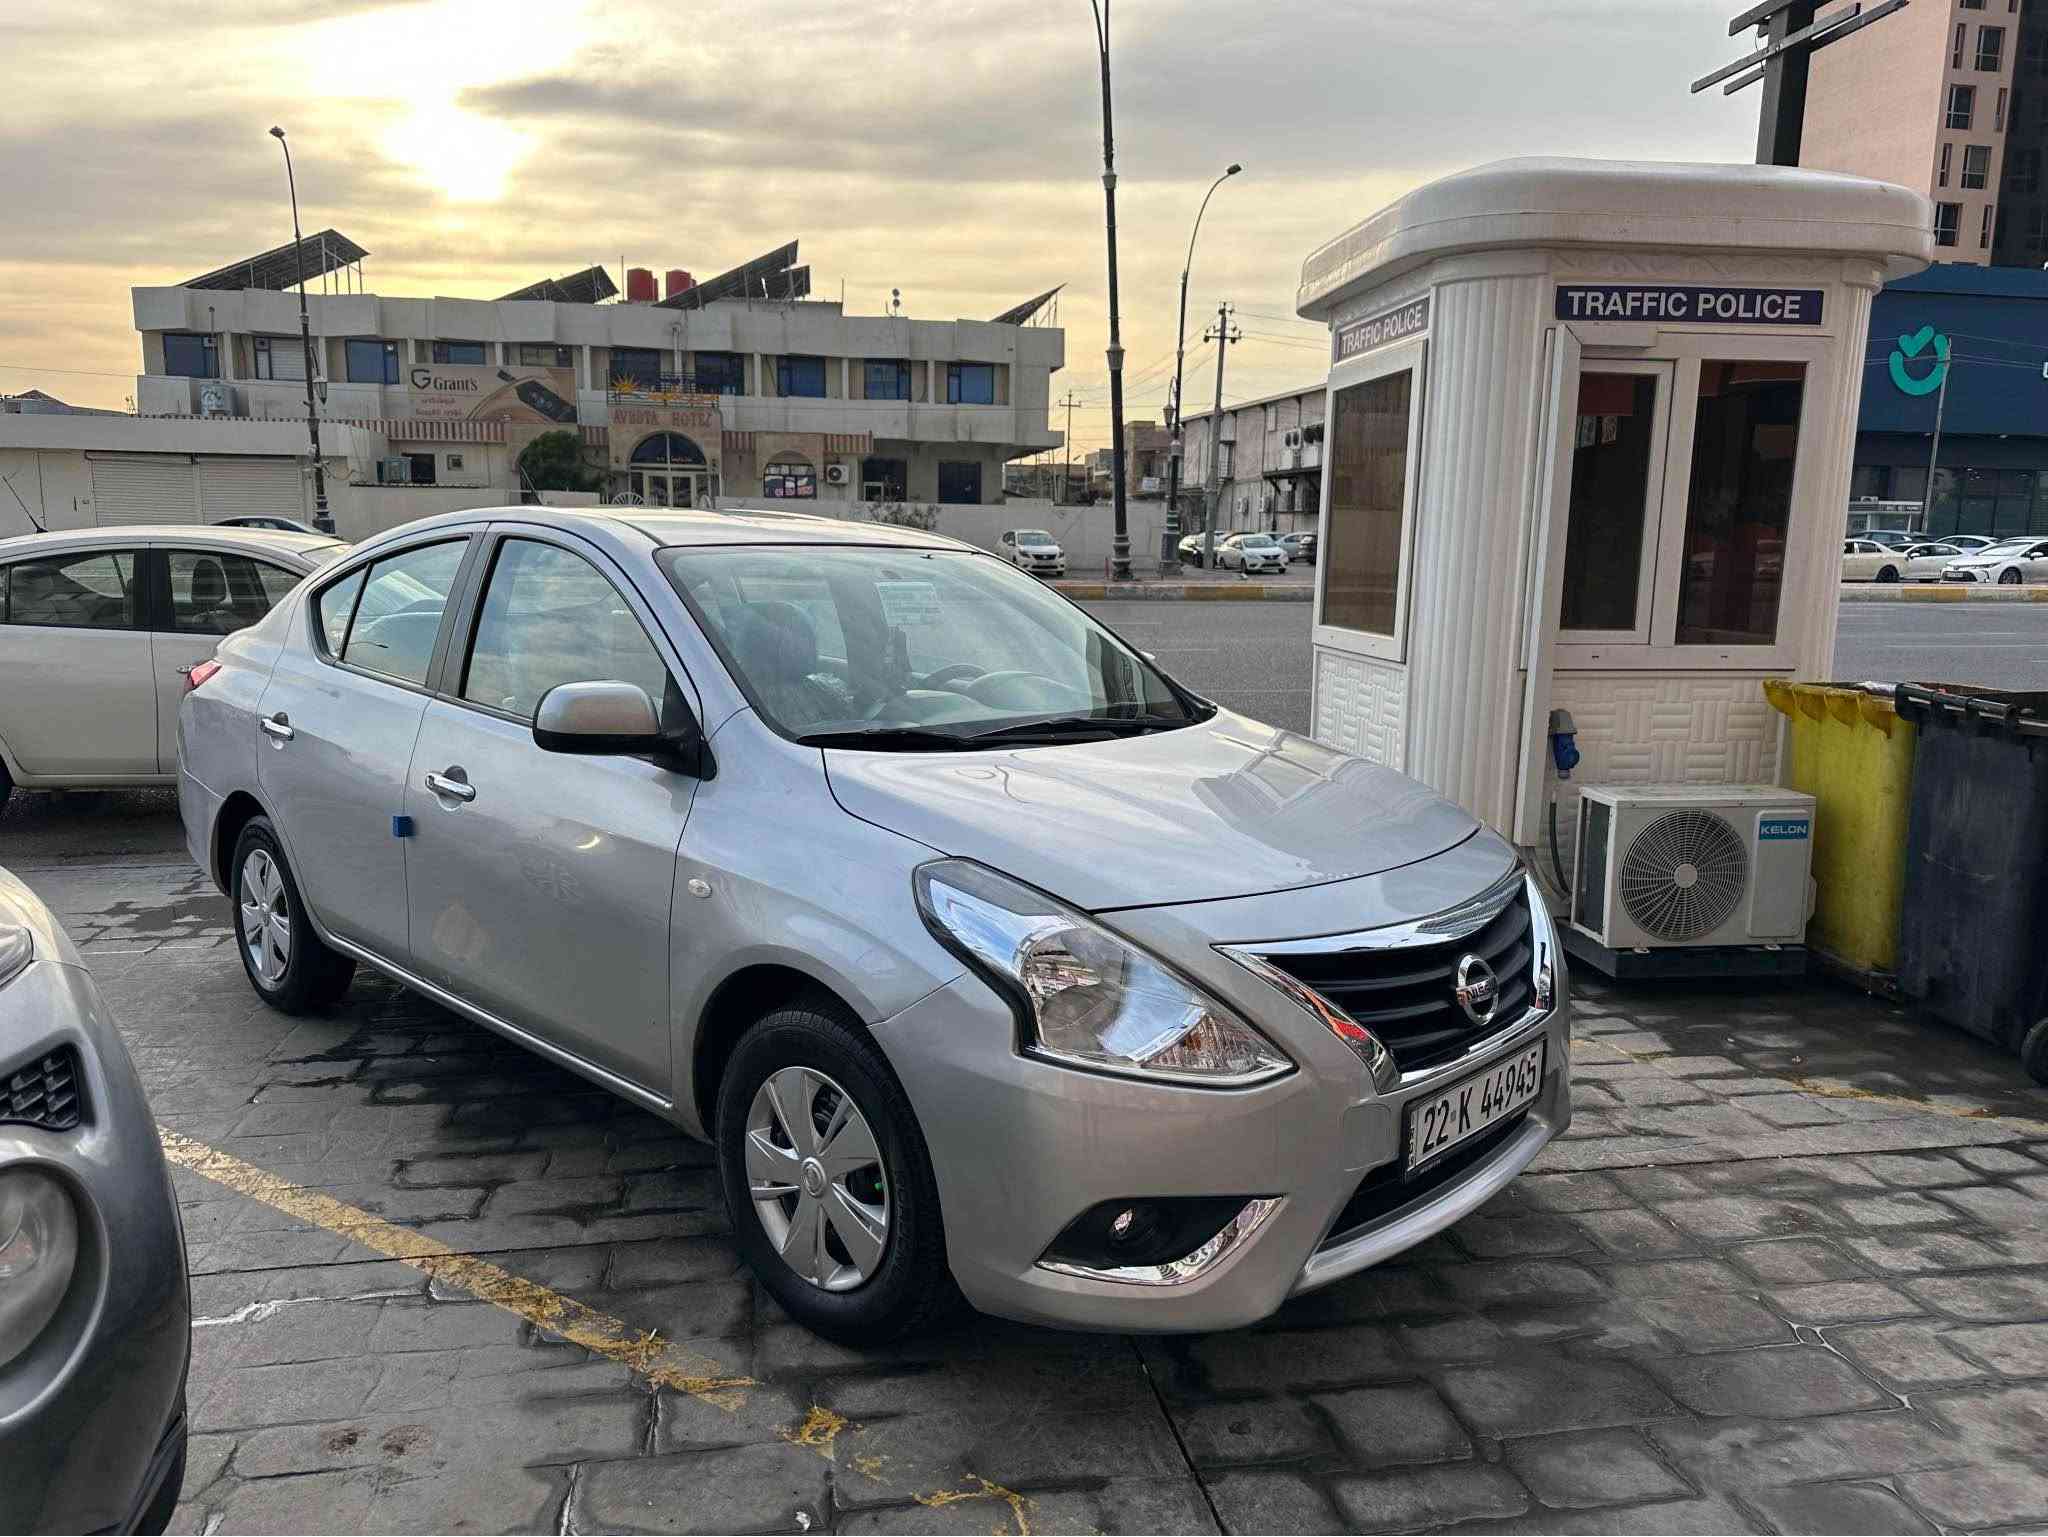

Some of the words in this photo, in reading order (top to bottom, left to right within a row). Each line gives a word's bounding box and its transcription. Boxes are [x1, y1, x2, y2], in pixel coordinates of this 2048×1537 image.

[1567, 291, 1688, 317] TRAFFIC
[1697, 293, 1802, 319] POLICE
[1341, 322, 1382, 356] TRAFFIC
[1382, 303, 1424, 340] POLICE
[1761, 825, 1807, 835] KELON
[1423, 1100, 1450, 1153] 22
[1481, 1052, 1537, 1118] 44945
